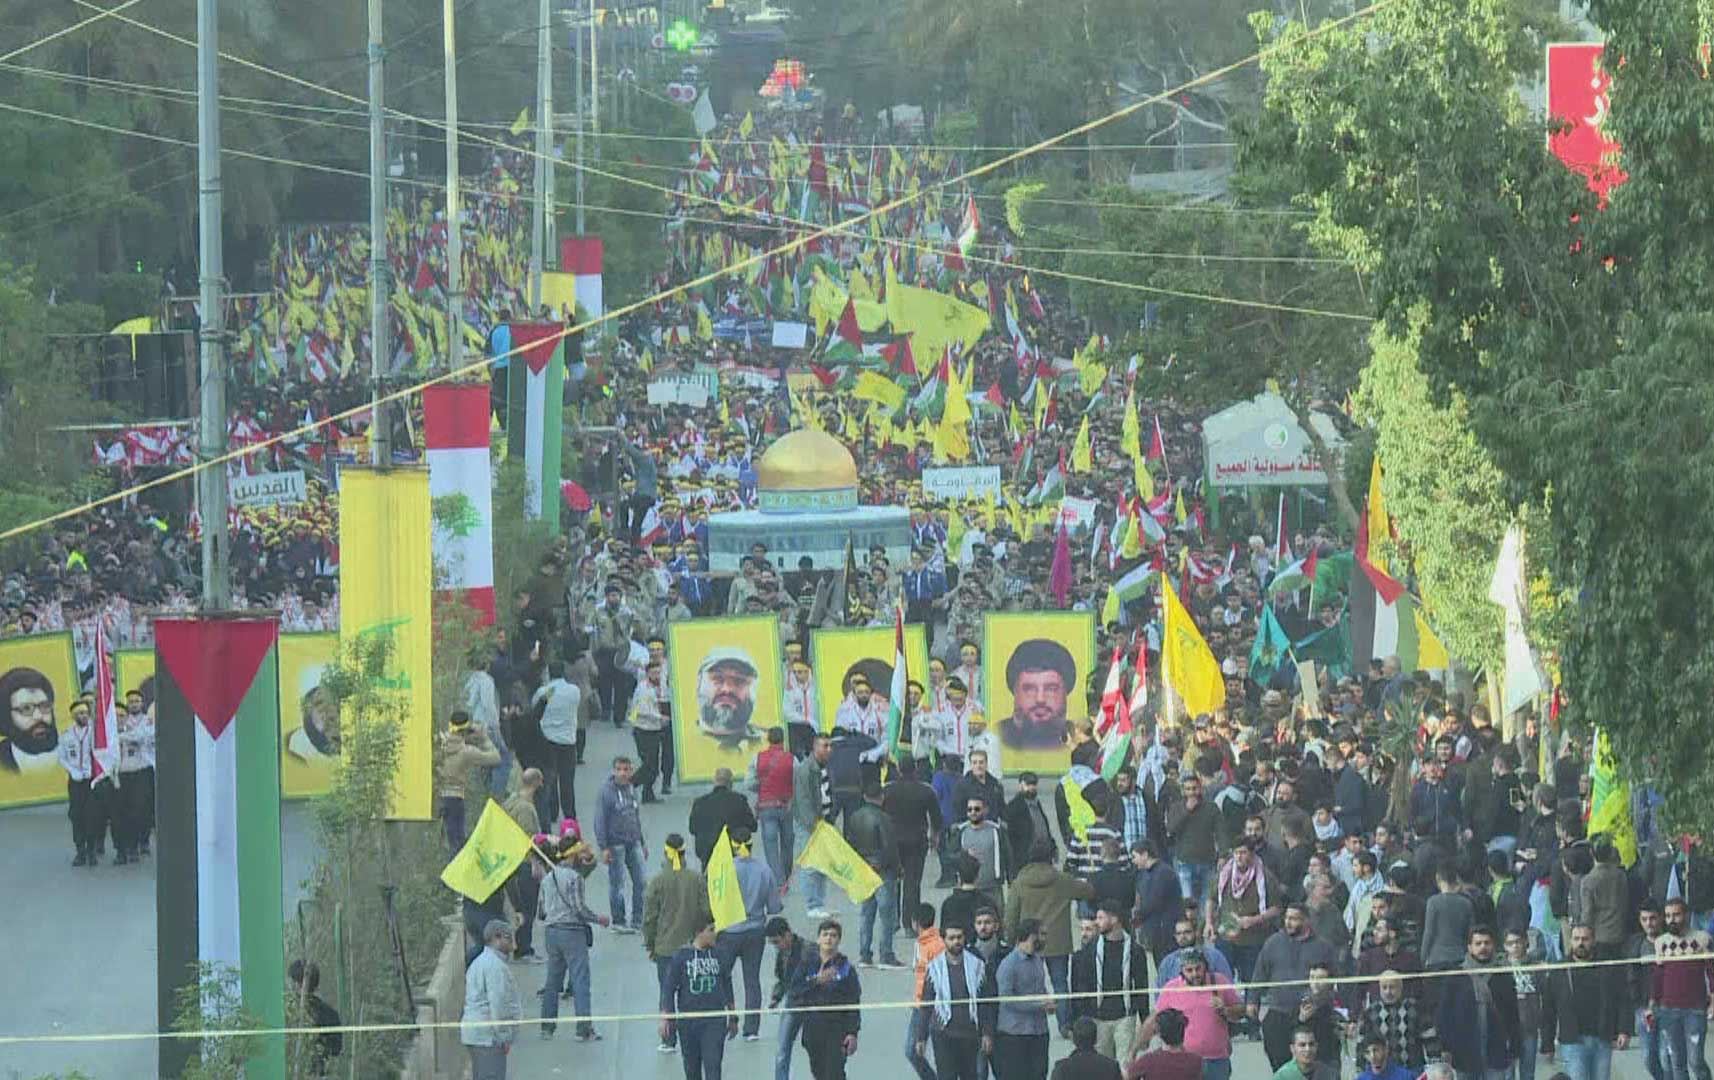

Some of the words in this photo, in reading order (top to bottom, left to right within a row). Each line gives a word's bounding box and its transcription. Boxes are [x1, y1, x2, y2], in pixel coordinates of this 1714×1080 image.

[1215, 457, 1251, 480] الجميع
[234, 477, 297, 500] القدس
[690, 976, 717, 994] UP
